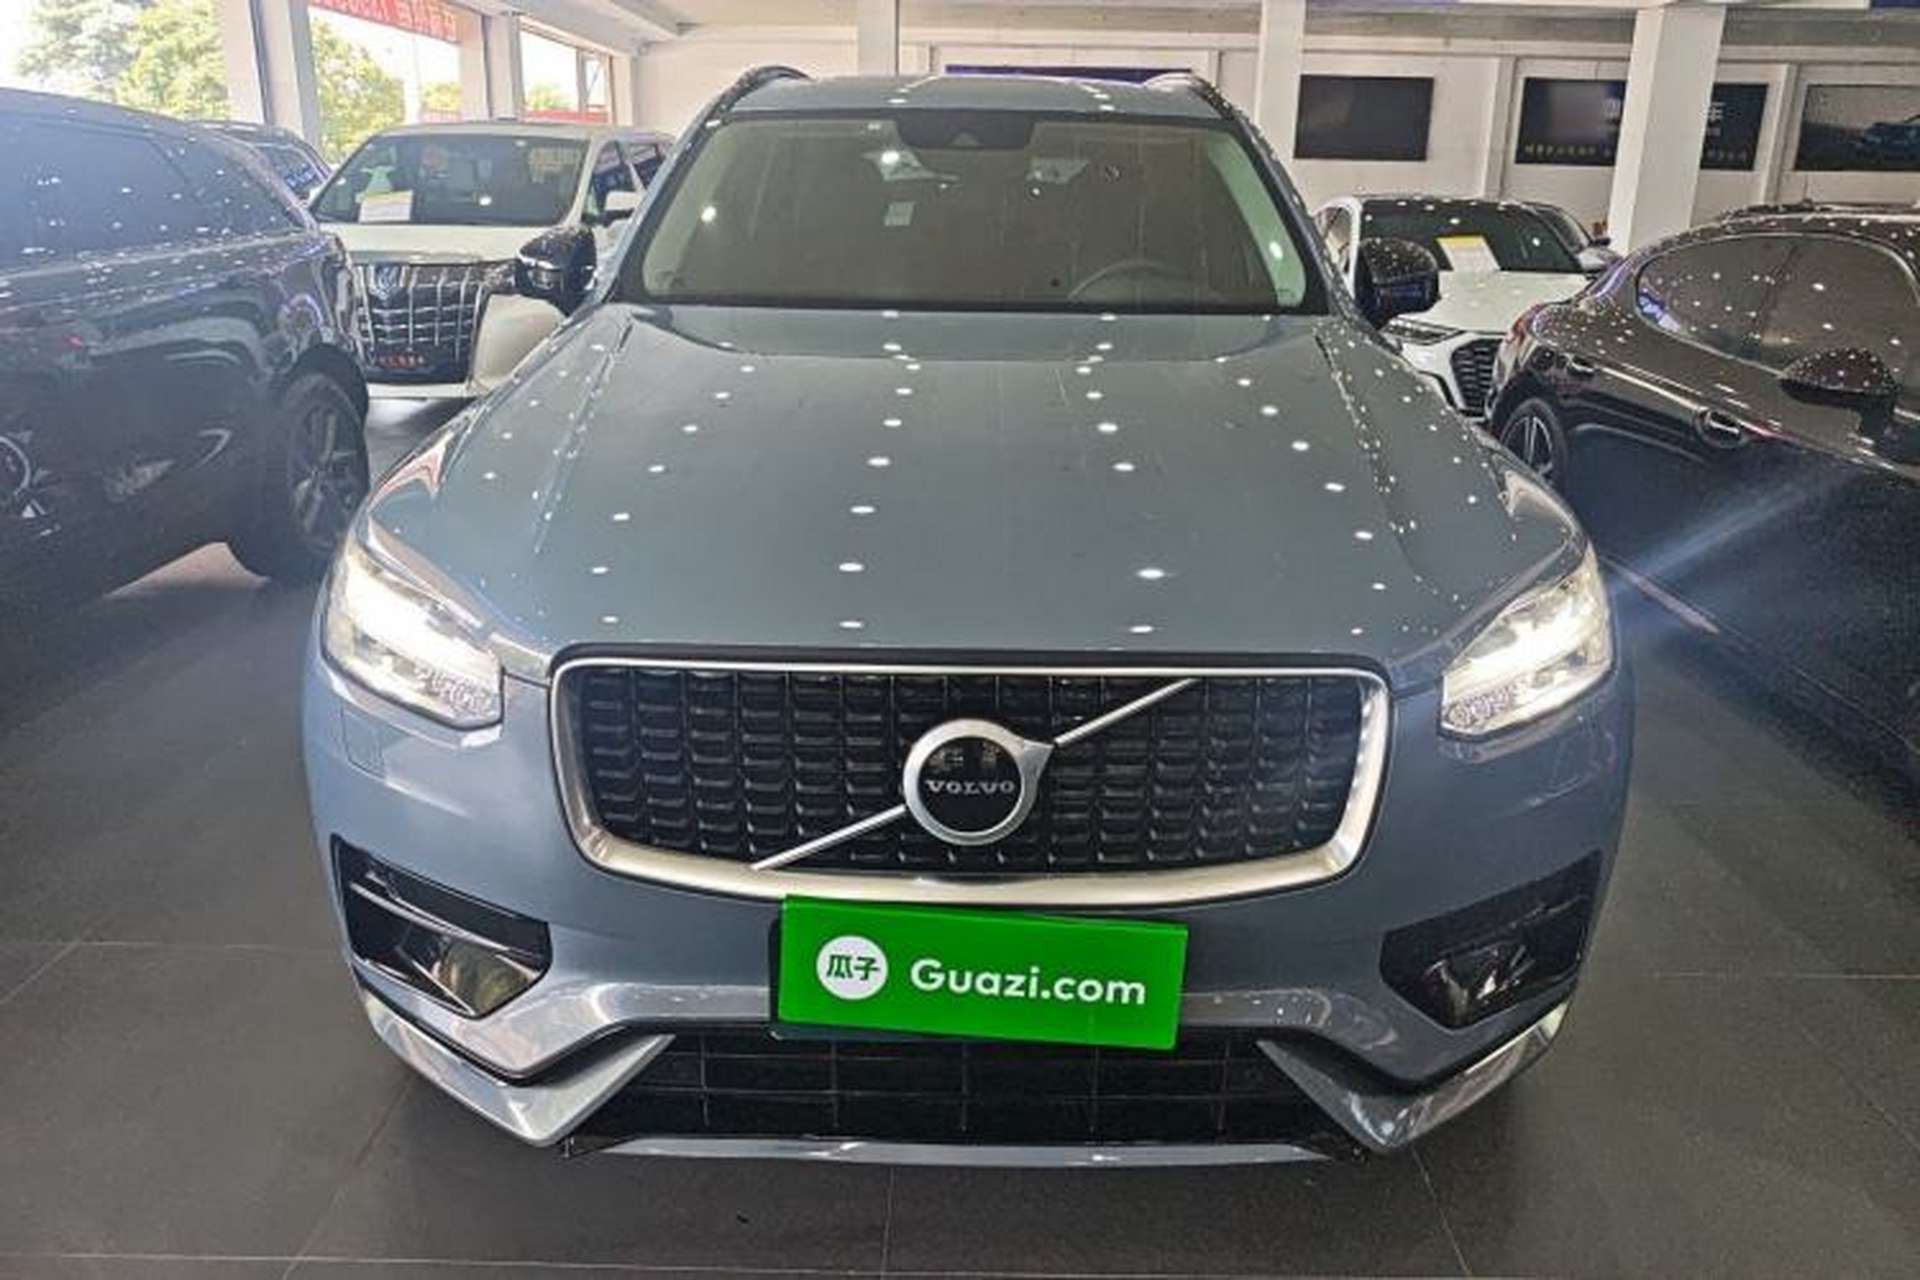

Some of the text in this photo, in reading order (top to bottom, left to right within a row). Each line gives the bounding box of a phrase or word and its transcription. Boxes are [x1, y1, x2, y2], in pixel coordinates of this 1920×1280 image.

[925, 780, 1016, 795] VOLVO
[826, 953, 881, 981] 瓜子
[910, 958, 1147, 1005] Guazi.com
